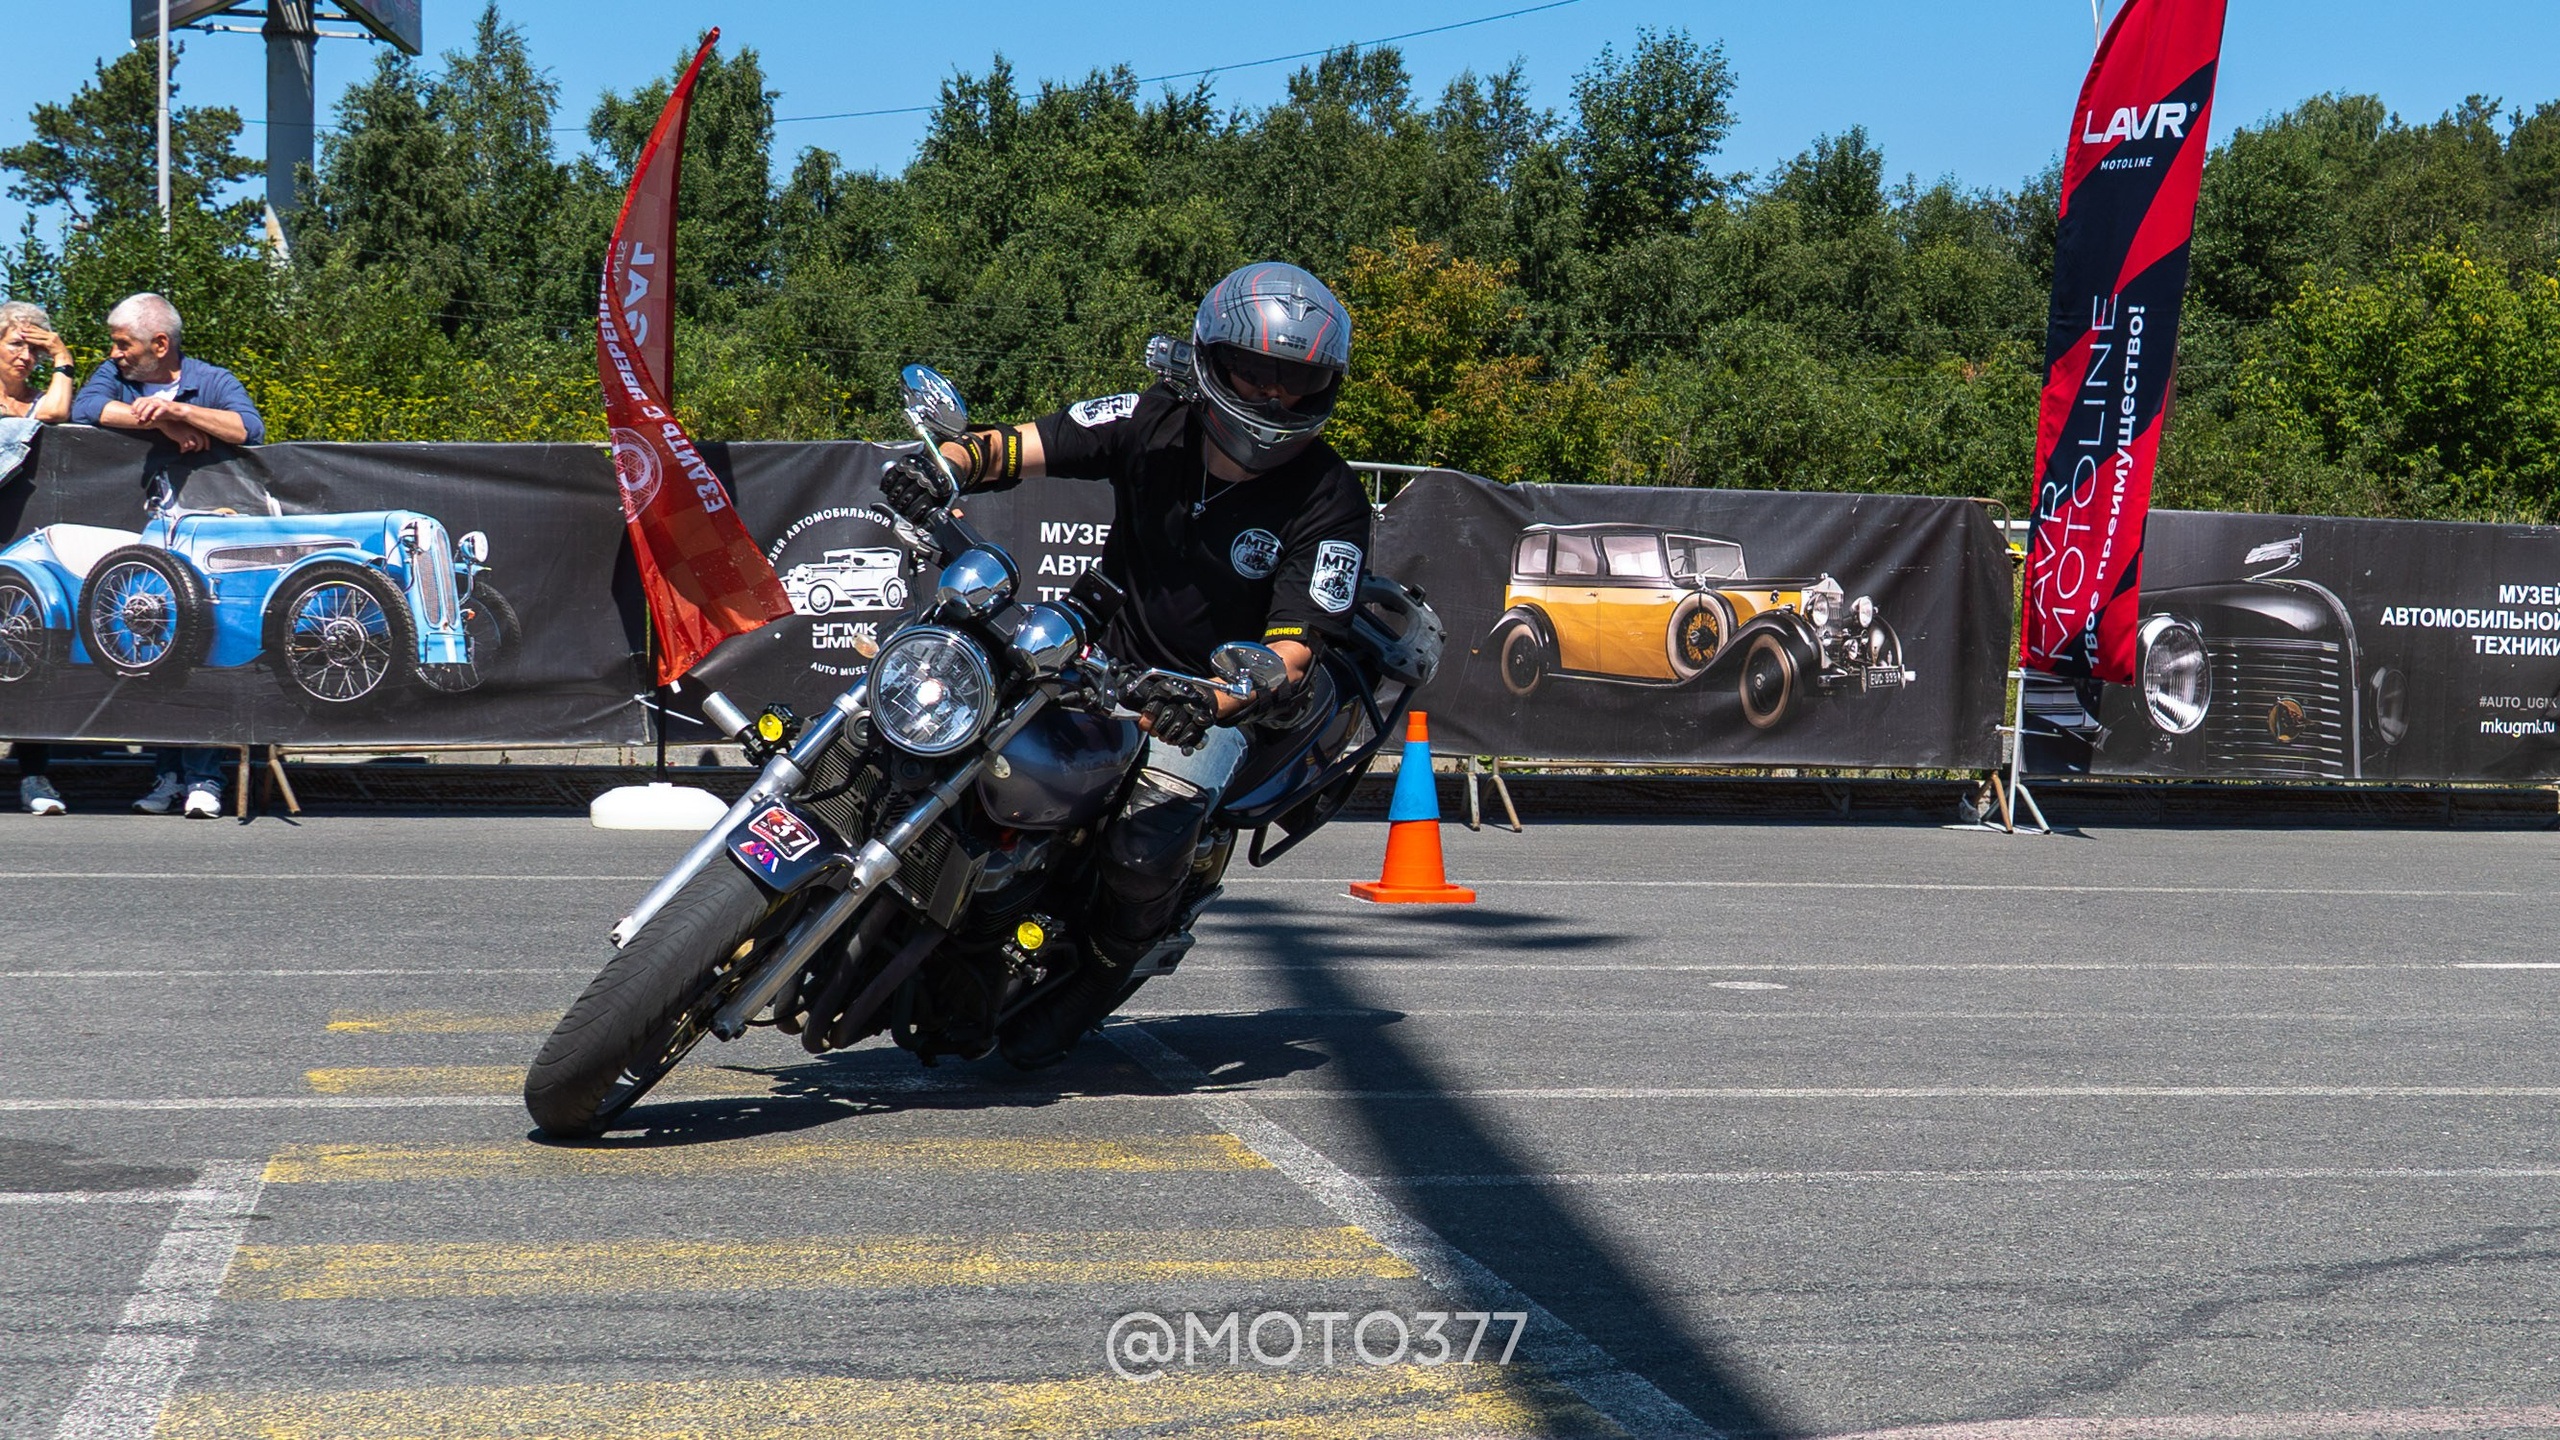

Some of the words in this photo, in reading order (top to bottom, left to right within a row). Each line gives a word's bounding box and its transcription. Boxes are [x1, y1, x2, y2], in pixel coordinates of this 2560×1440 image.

[2082, 102, 2185, 144] LAVR
[2100, 156, 2154, 170] MOTOLINE
[662, 422, 726, 513] ЕЗДИТЬ
[2049, 293, 2118, 662] MOTOLINE
[1040, 521, 1112, 545] МУЗЕ
[766, 537, 788, 568] УЗЕЙ
[2030, 481, 2068, 657] LAVR
[812, 622, 878, 636] УГМК
[812, 635, 877, 649] UMM
[810, 661, 837, 675] AUTO
[840, 665, 869, 676] MUSE
[772, 819, 811, 848] 37
